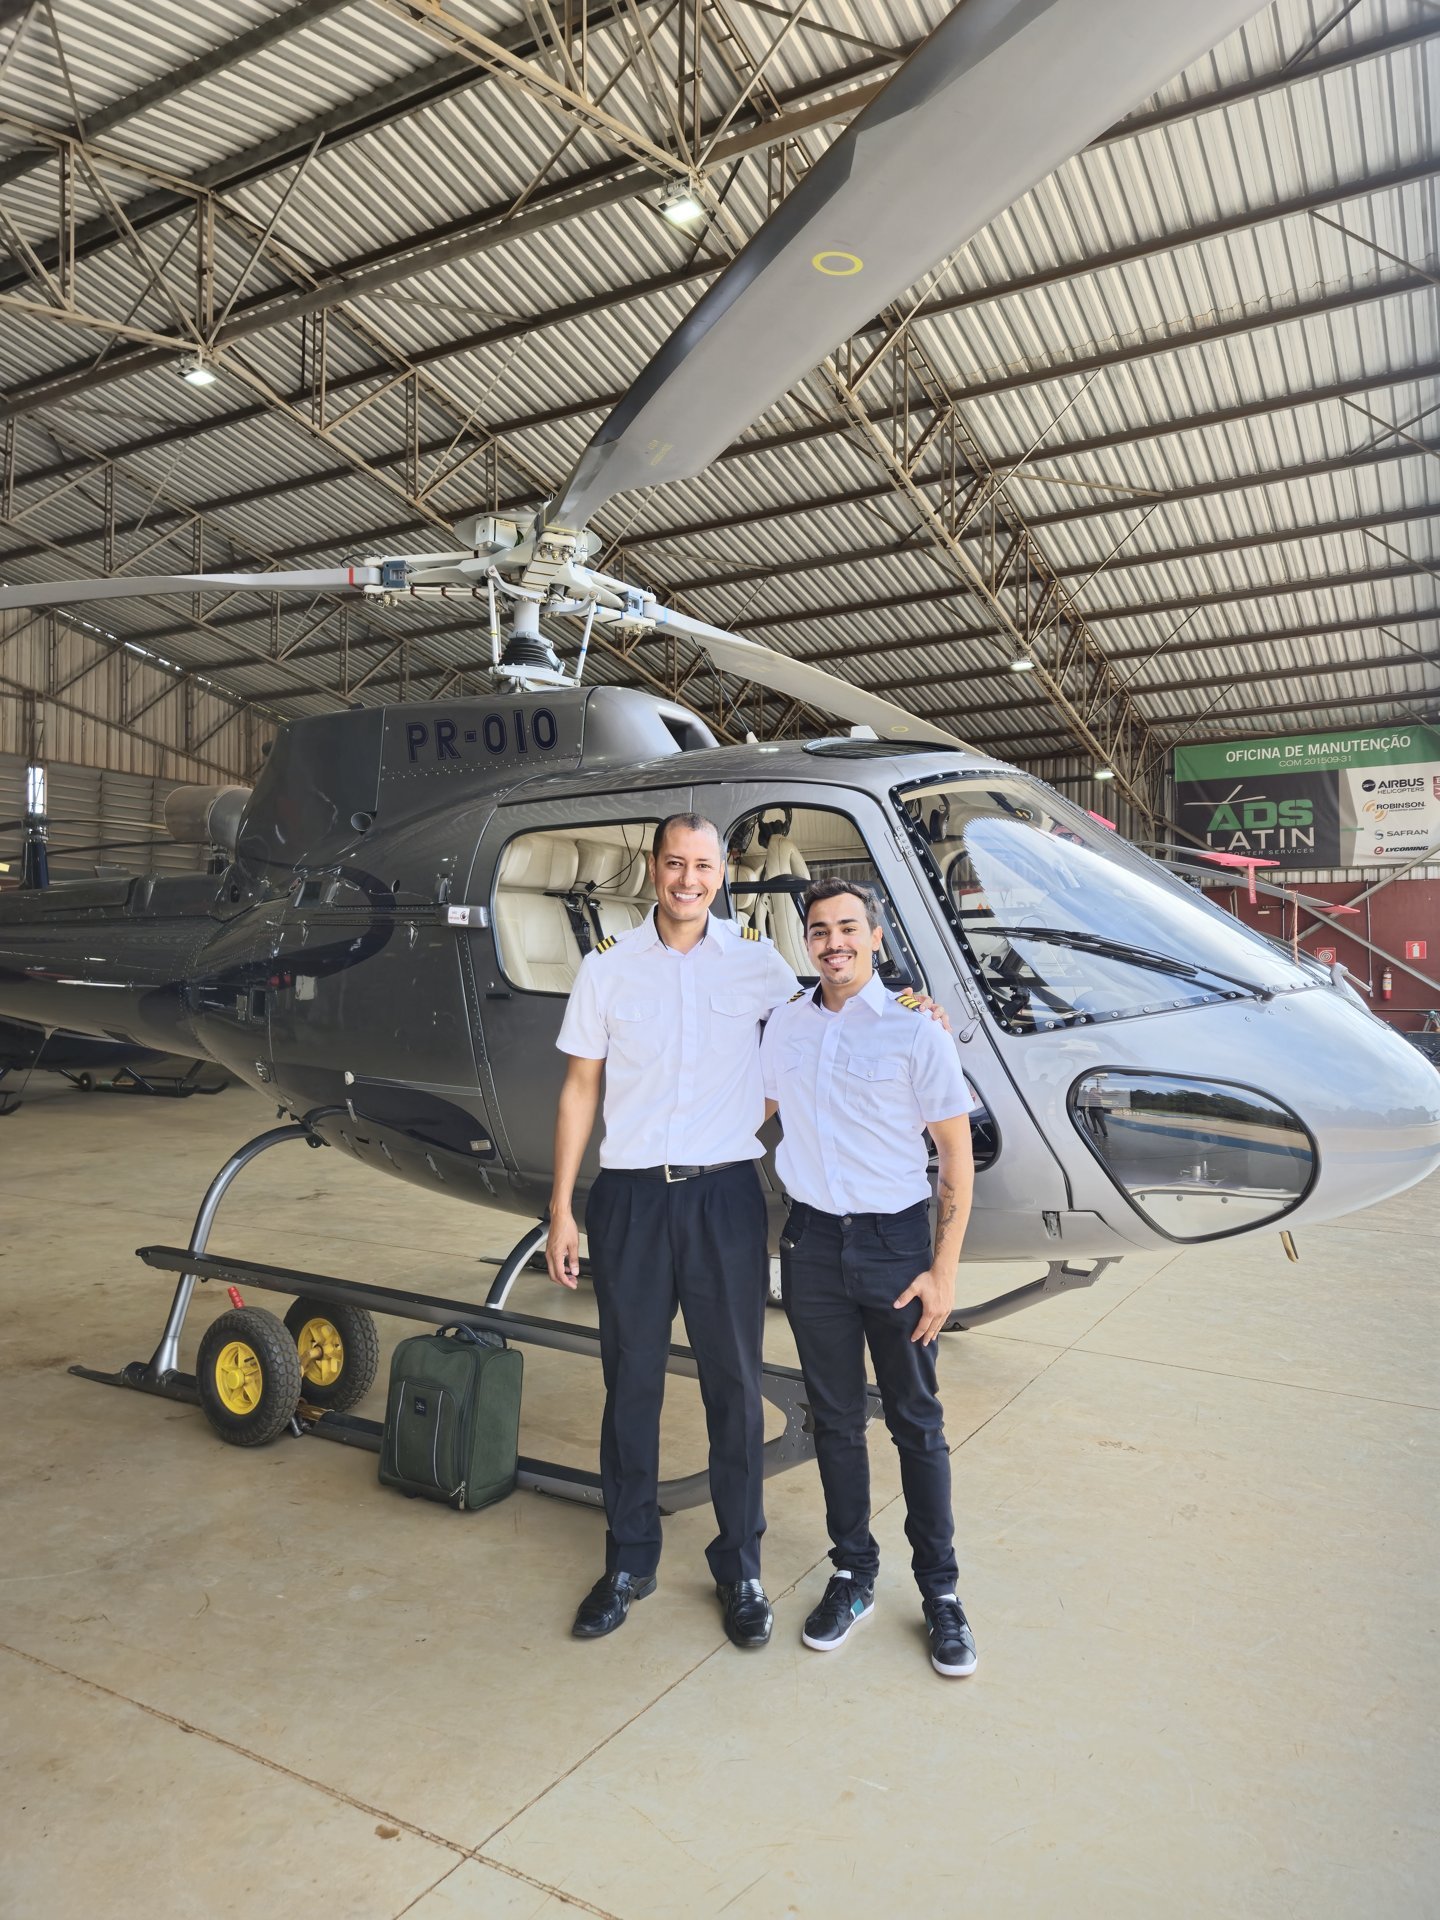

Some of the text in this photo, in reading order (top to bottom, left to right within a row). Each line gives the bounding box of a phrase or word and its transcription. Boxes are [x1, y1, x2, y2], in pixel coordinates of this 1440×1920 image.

[1226, 735, 1411, 763] OFICINA DE MANUTENÇÃO
[1279, 755, 1352, 768] COM 201509-31
[1378, 778, 1424, 789] AIRBUS
[1376, 801, 1424, 810] ROBINSON
[1206, 799, 1314, 832] ADS
[1386, 829, 1429, 837] SAFRAN
[1206, 827, 1315, 851] LATIN
[1268, 848, 1315, 856] SERVICES
[1385, 845, 1429, 853] LYCOMING
